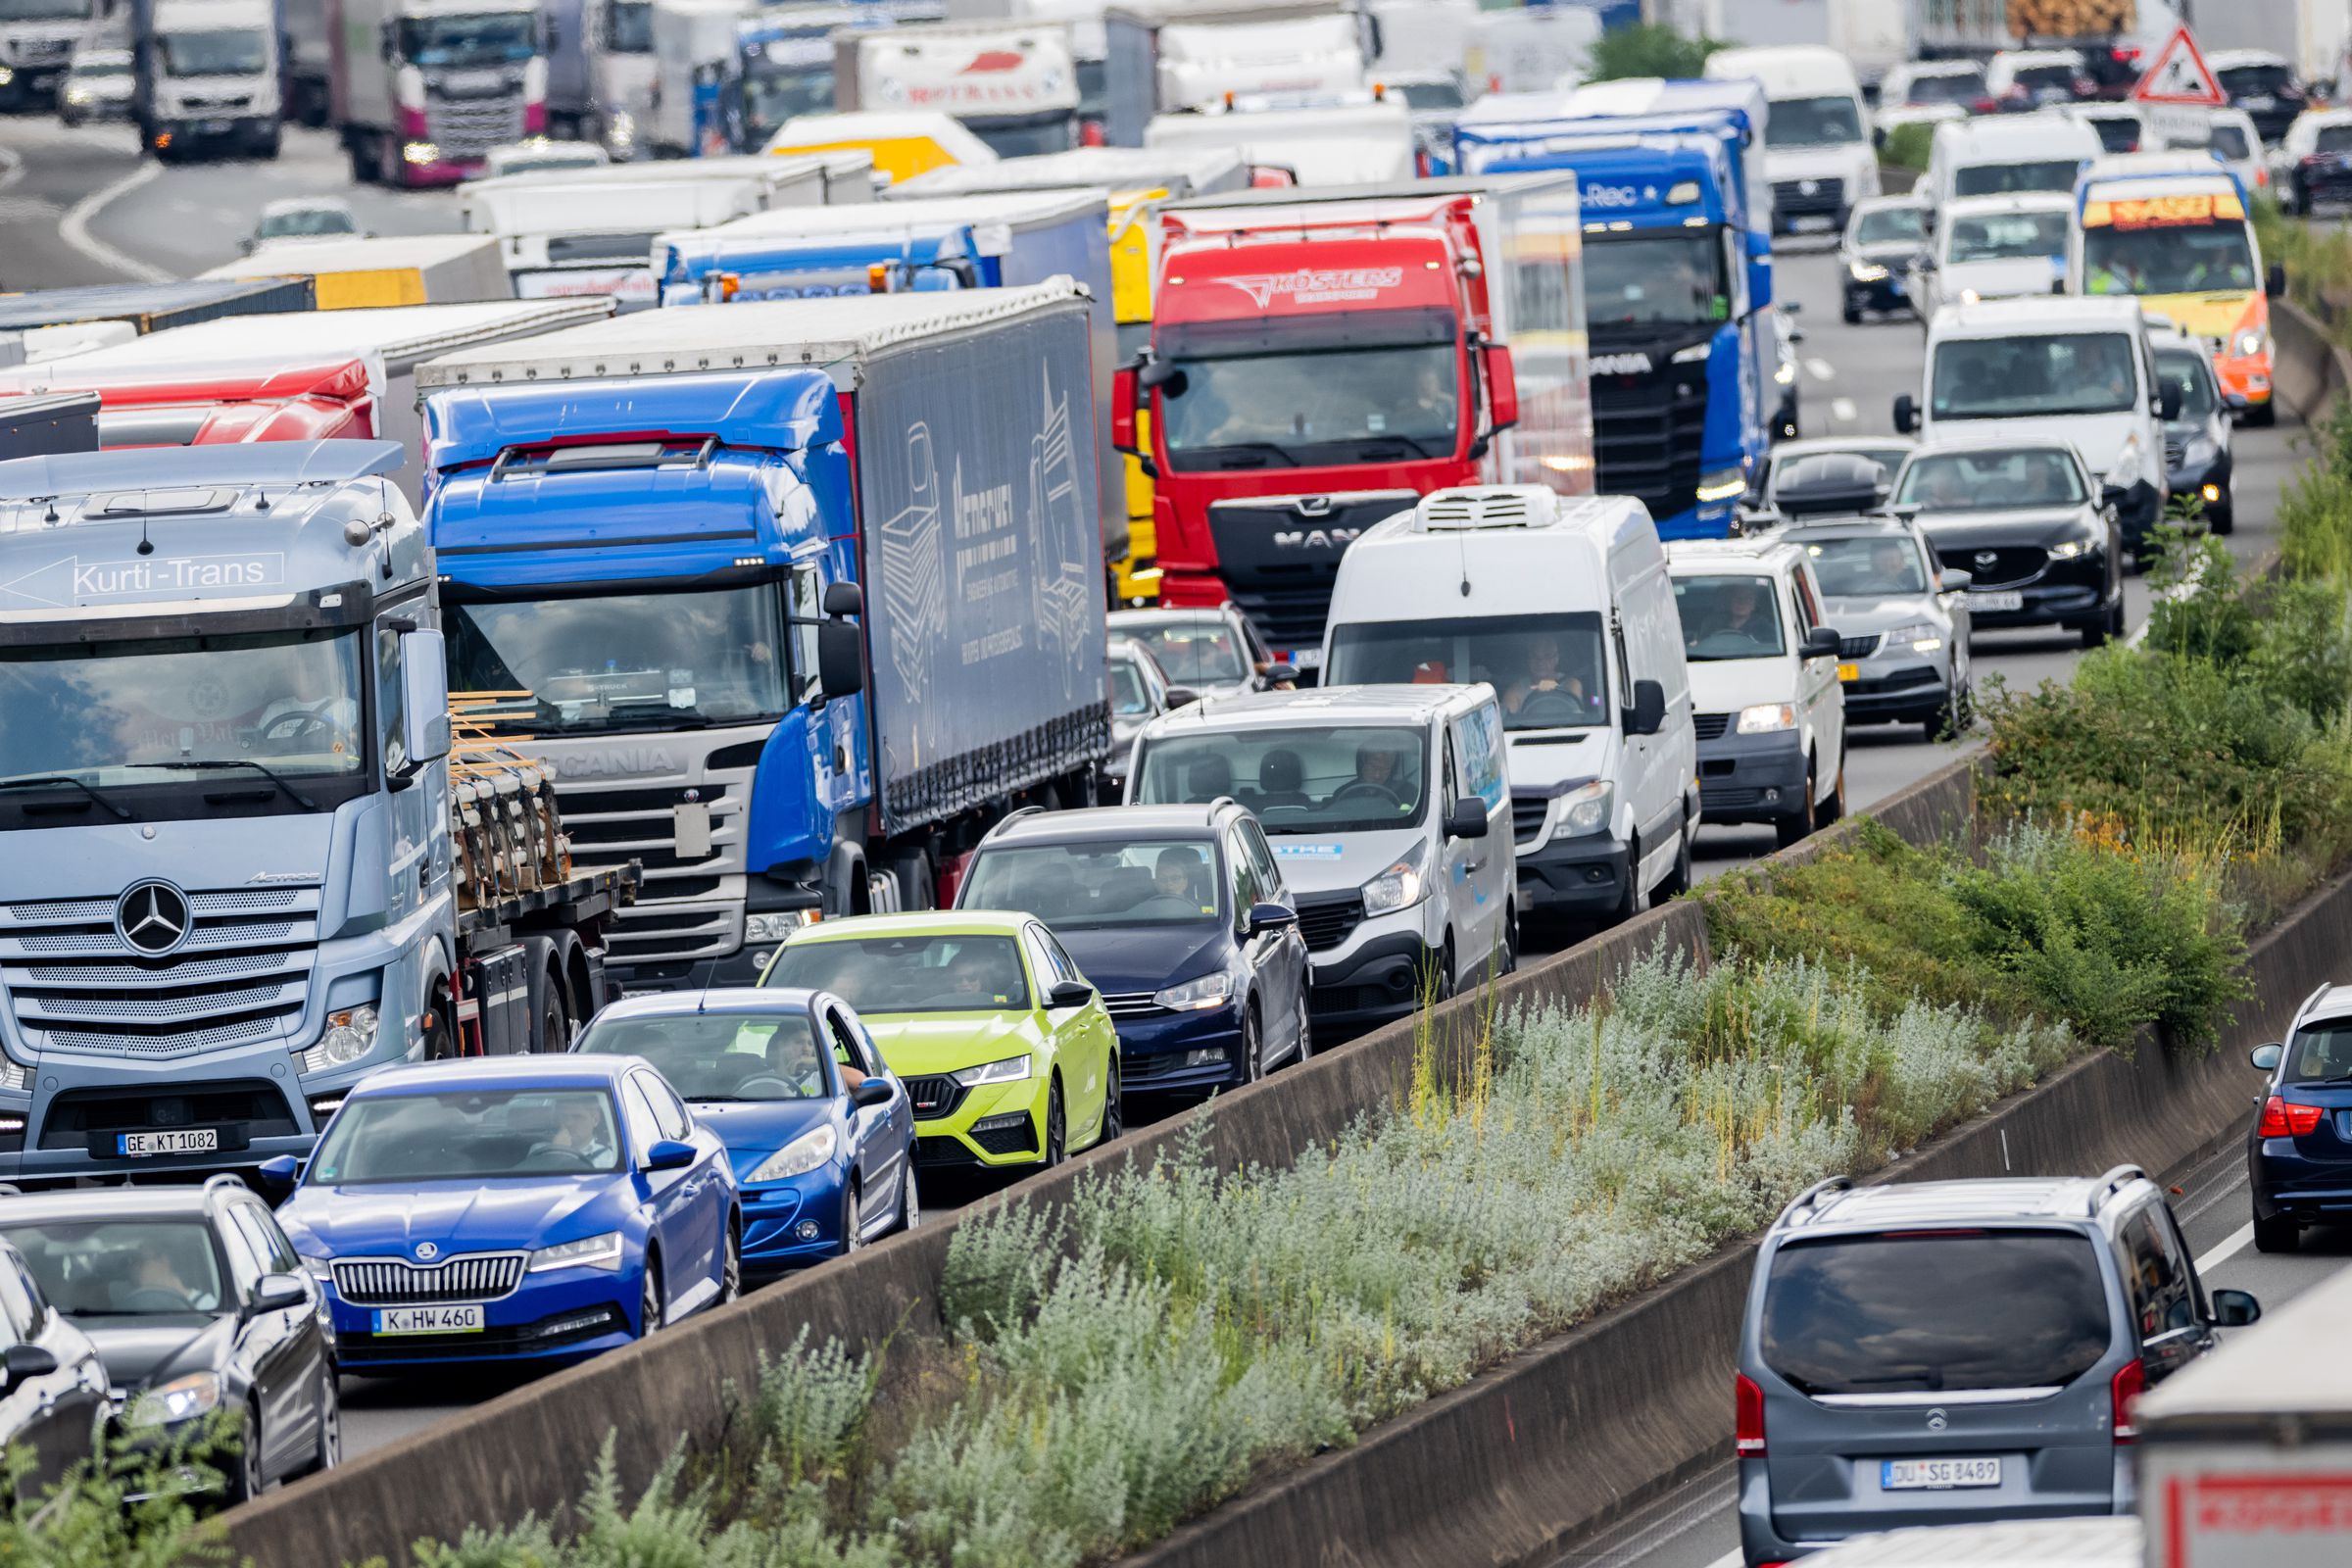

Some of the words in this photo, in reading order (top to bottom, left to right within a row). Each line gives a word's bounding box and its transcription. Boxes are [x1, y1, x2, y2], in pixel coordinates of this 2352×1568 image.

[1274, 528, 1360, 549] MAN
[127, 1136, 146, 1152] GE
[157, 1134, 175, 1150] KT
[179, 1132, 216, 1149] 1082
[388, 1311, 399, 1329] K
[413, 1309, 436, 1328] HW
[441, 1308, 475, 1327] 460
[1928, 1463, 1950, 1481] SG
